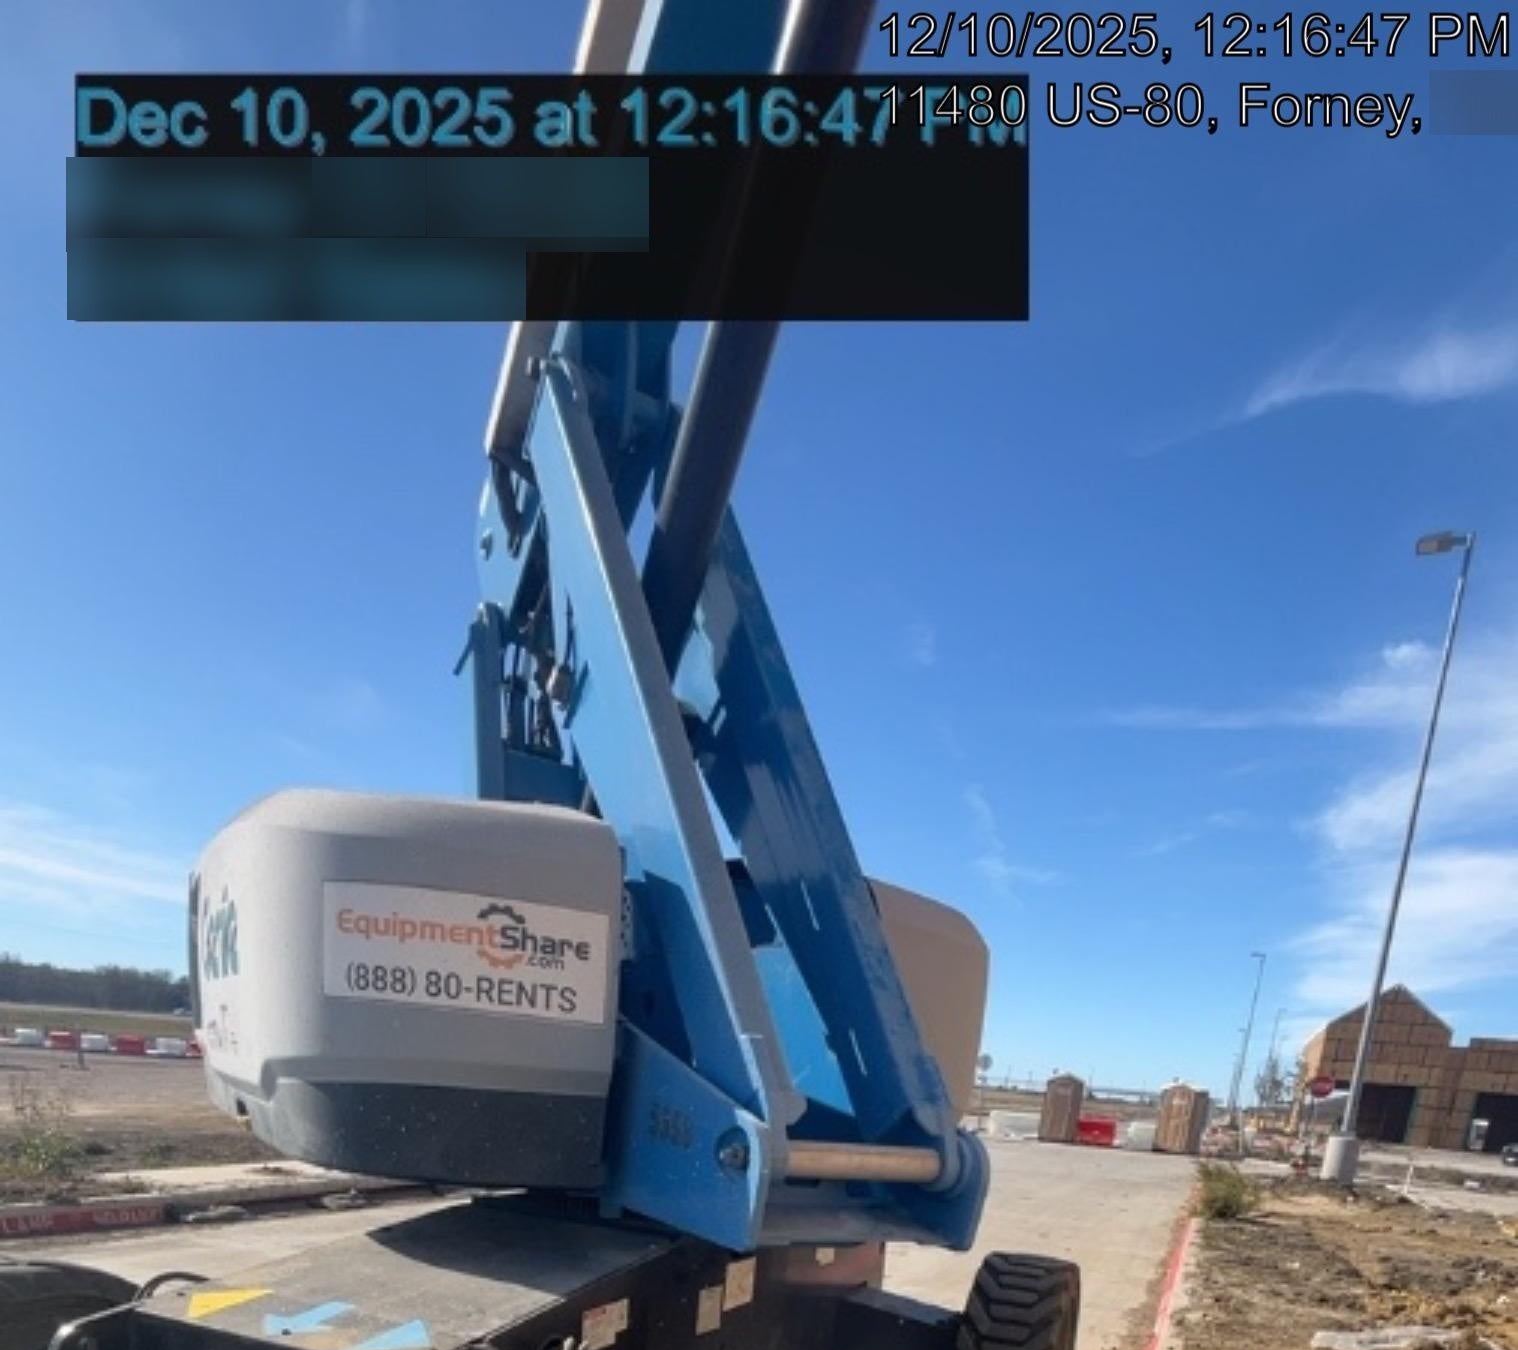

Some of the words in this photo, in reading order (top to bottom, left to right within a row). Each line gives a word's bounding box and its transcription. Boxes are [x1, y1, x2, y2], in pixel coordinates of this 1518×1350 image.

[337, 908, 592, 961] EquipmentShare
[346, 961, 417, 995] (888)
[425, 970, 578, 1014] 80-RENTS
